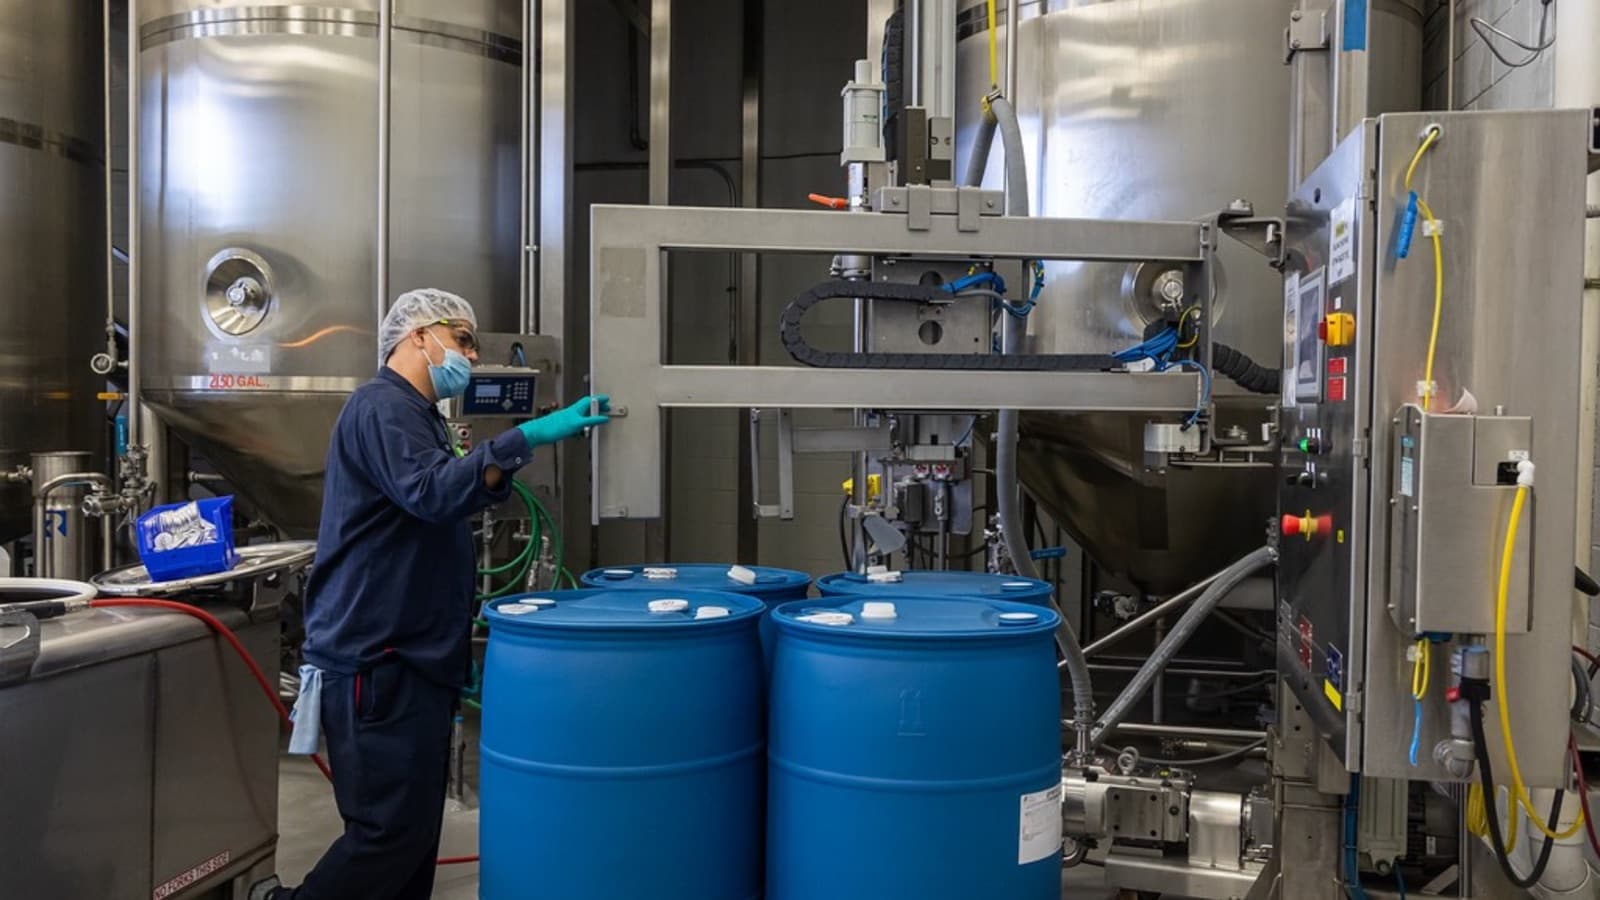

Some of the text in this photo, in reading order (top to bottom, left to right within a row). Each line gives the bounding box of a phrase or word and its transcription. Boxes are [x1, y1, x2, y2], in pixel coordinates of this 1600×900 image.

[154, 853, 228, 899] NO FORKS THIS SIDE
